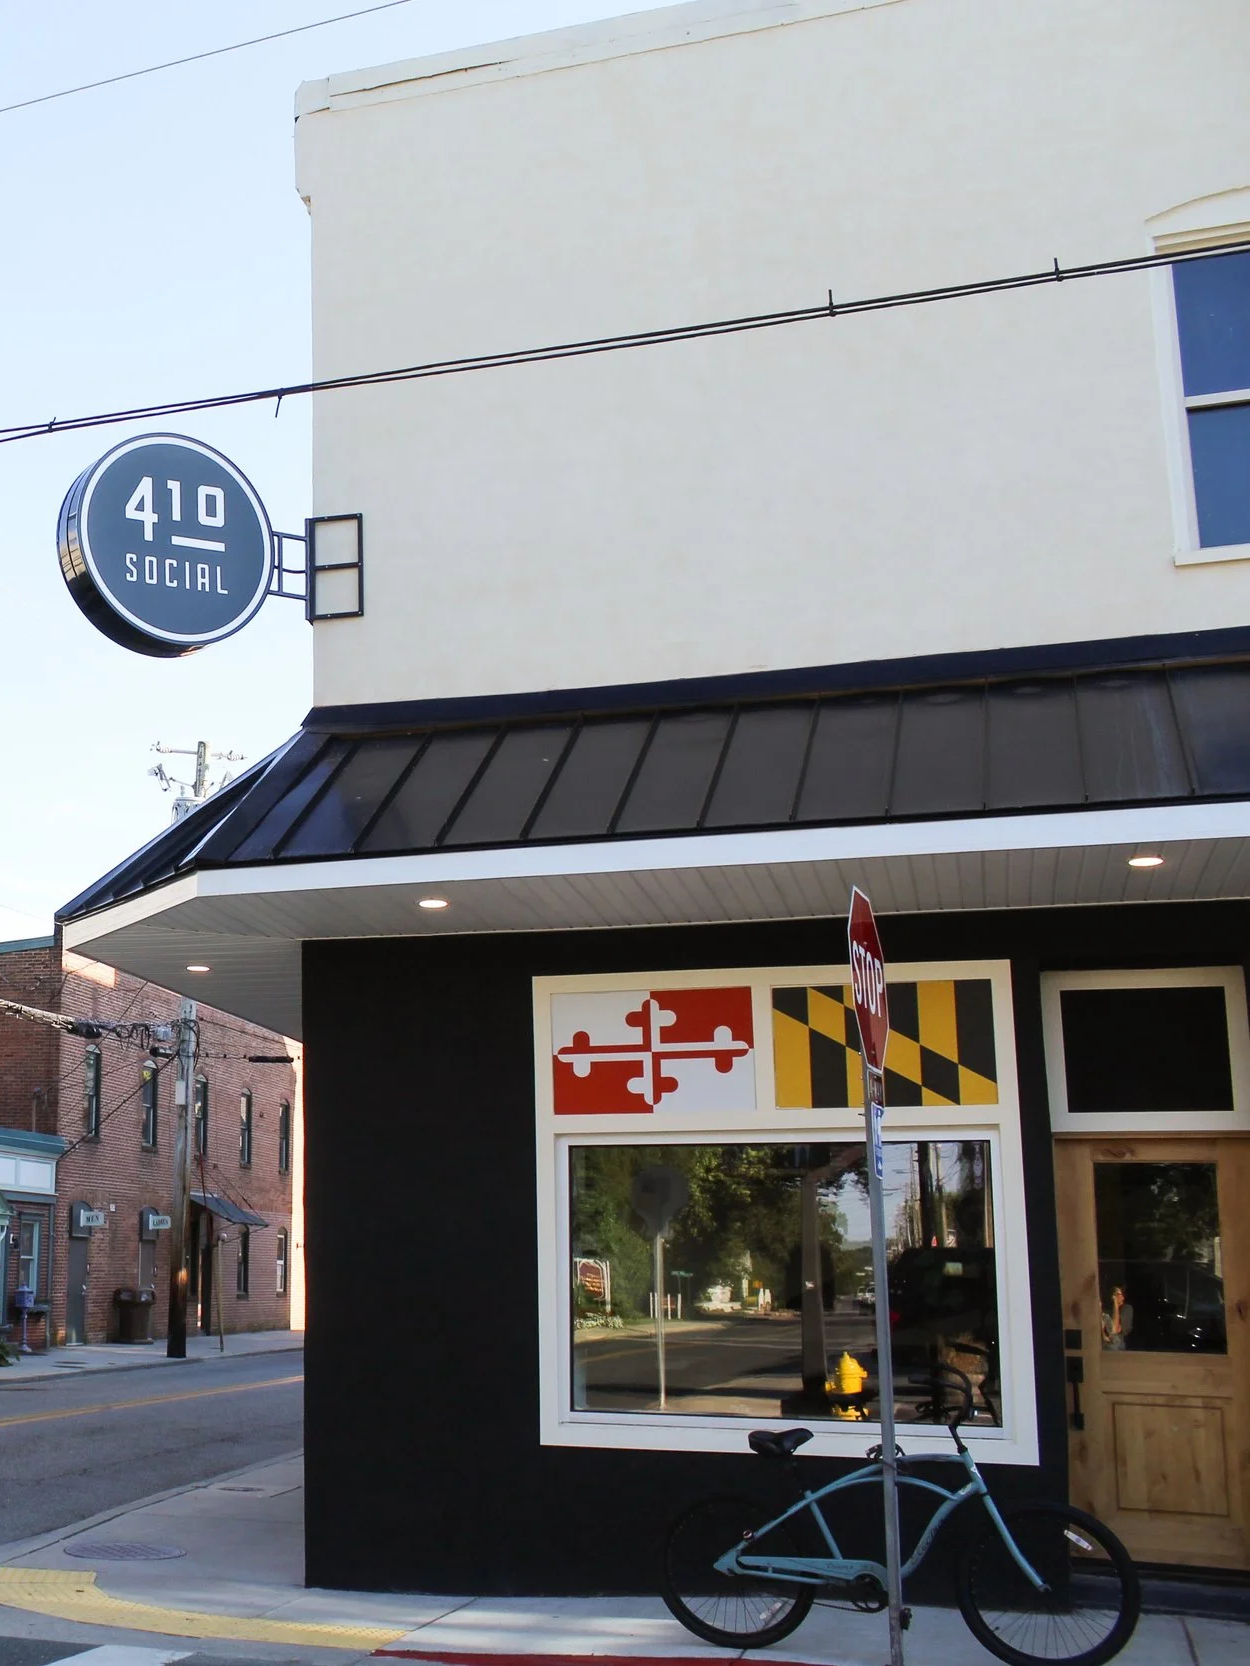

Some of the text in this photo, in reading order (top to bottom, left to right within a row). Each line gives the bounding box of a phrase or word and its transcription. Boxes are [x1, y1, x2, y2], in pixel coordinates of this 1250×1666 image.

[125, 476, 225, 542] 410
[125, 553, 229, 595] SOCIAL
[852, 940, 883, 1018] STOP
